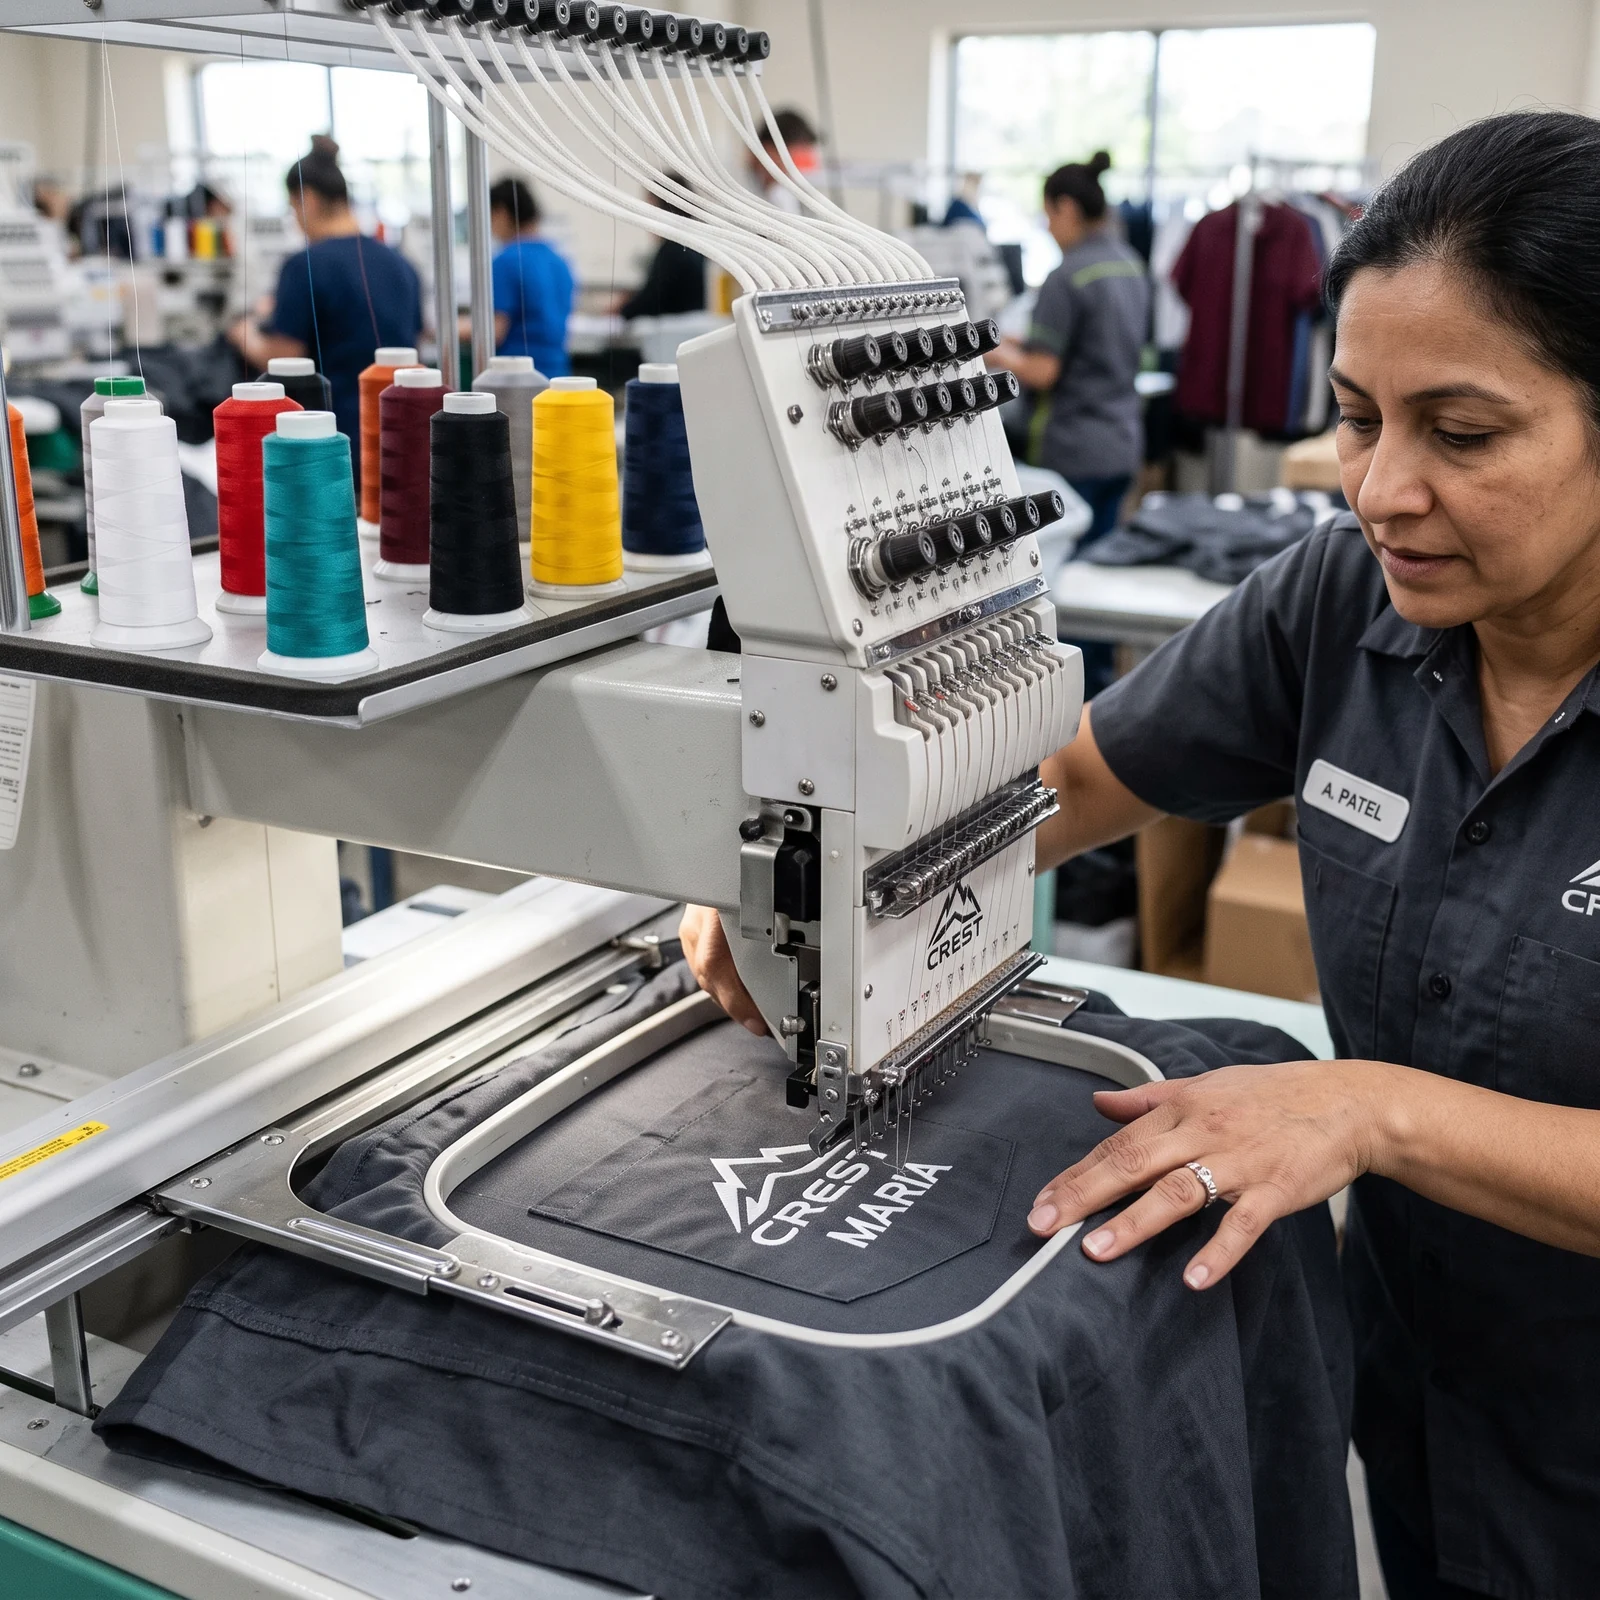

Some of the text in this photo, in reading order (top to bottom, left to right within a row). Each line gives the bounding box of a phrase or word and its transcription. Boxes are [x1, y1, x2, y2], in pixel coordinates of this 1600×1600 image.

[1321, 782, 1382, 822] A. PATEL
[927, 914, 984, 971] CREST
[826, 1162, 953, 1249] MARIA
